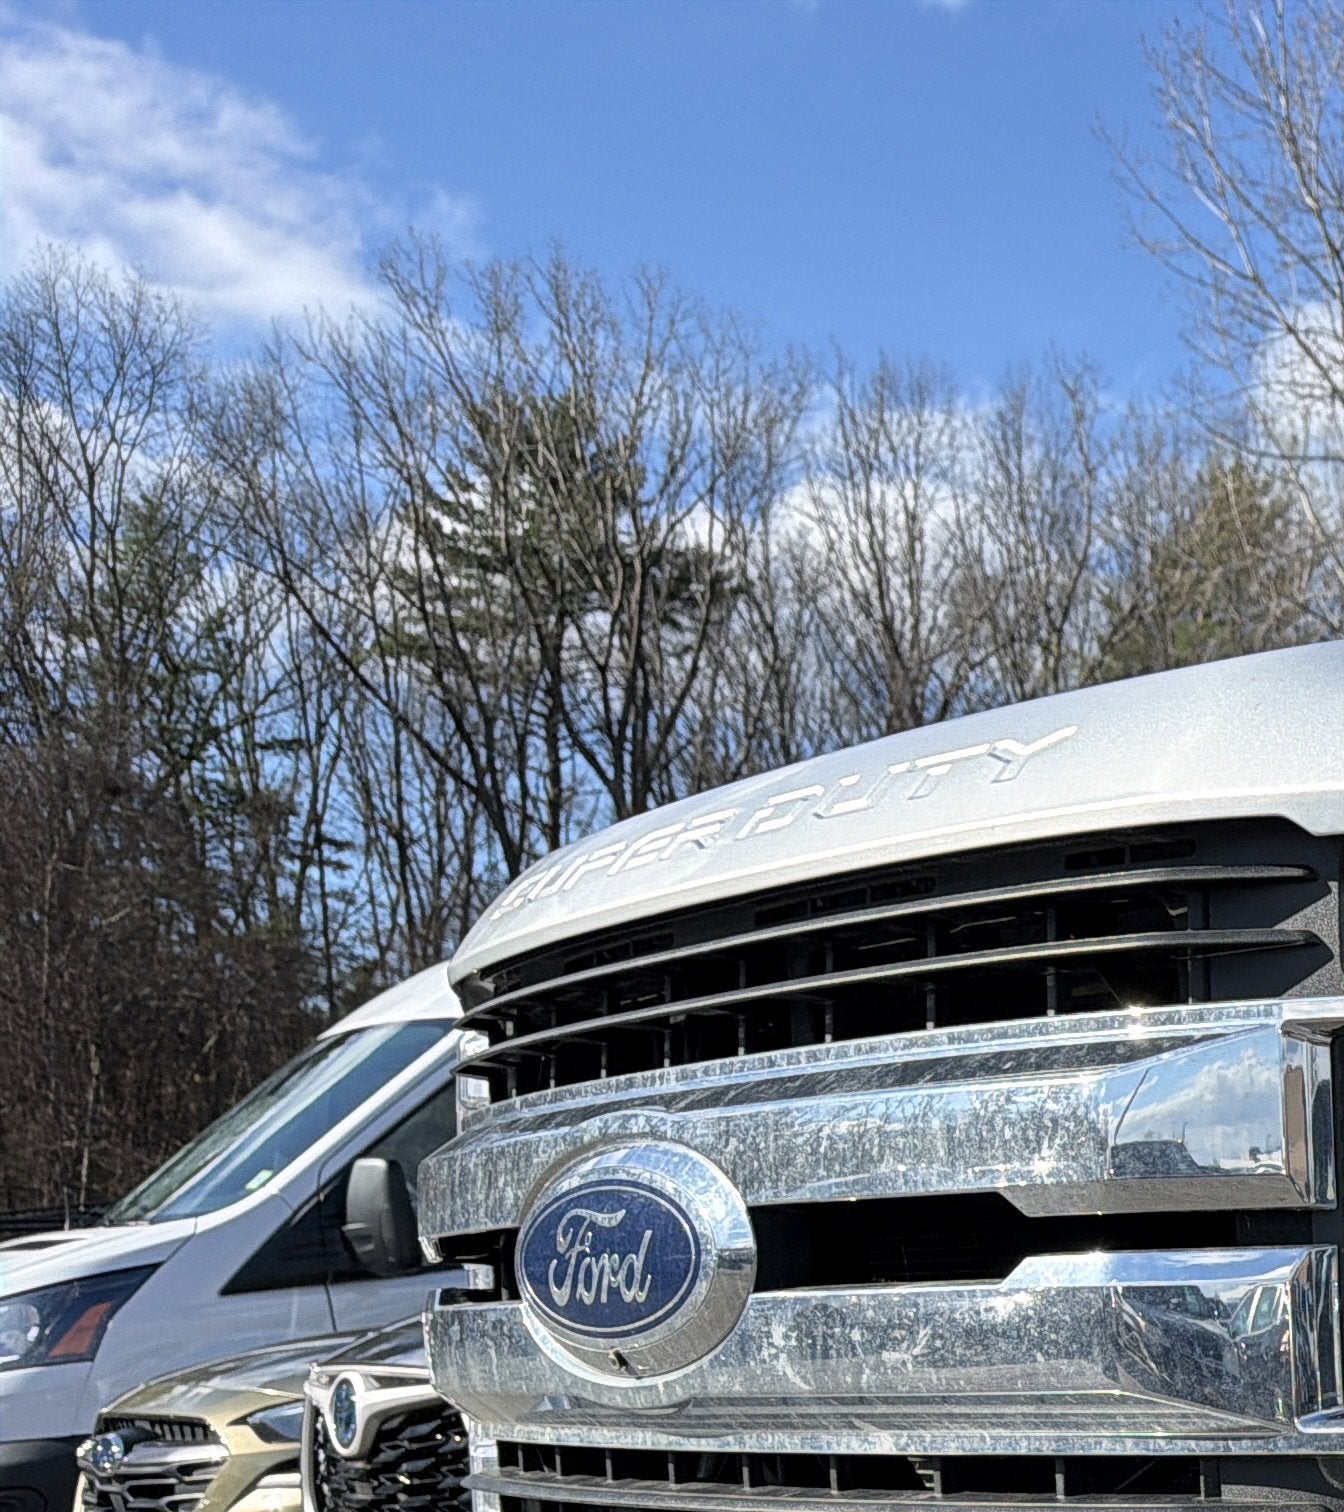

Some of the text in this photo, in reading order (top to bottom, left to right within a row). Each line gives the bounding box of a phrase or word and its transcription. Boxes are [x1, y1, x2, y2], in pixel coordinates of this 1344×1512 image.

[490, 725, 1080, 921] SUPER DUTY
[548, 1208, 653, 1307] Ford
